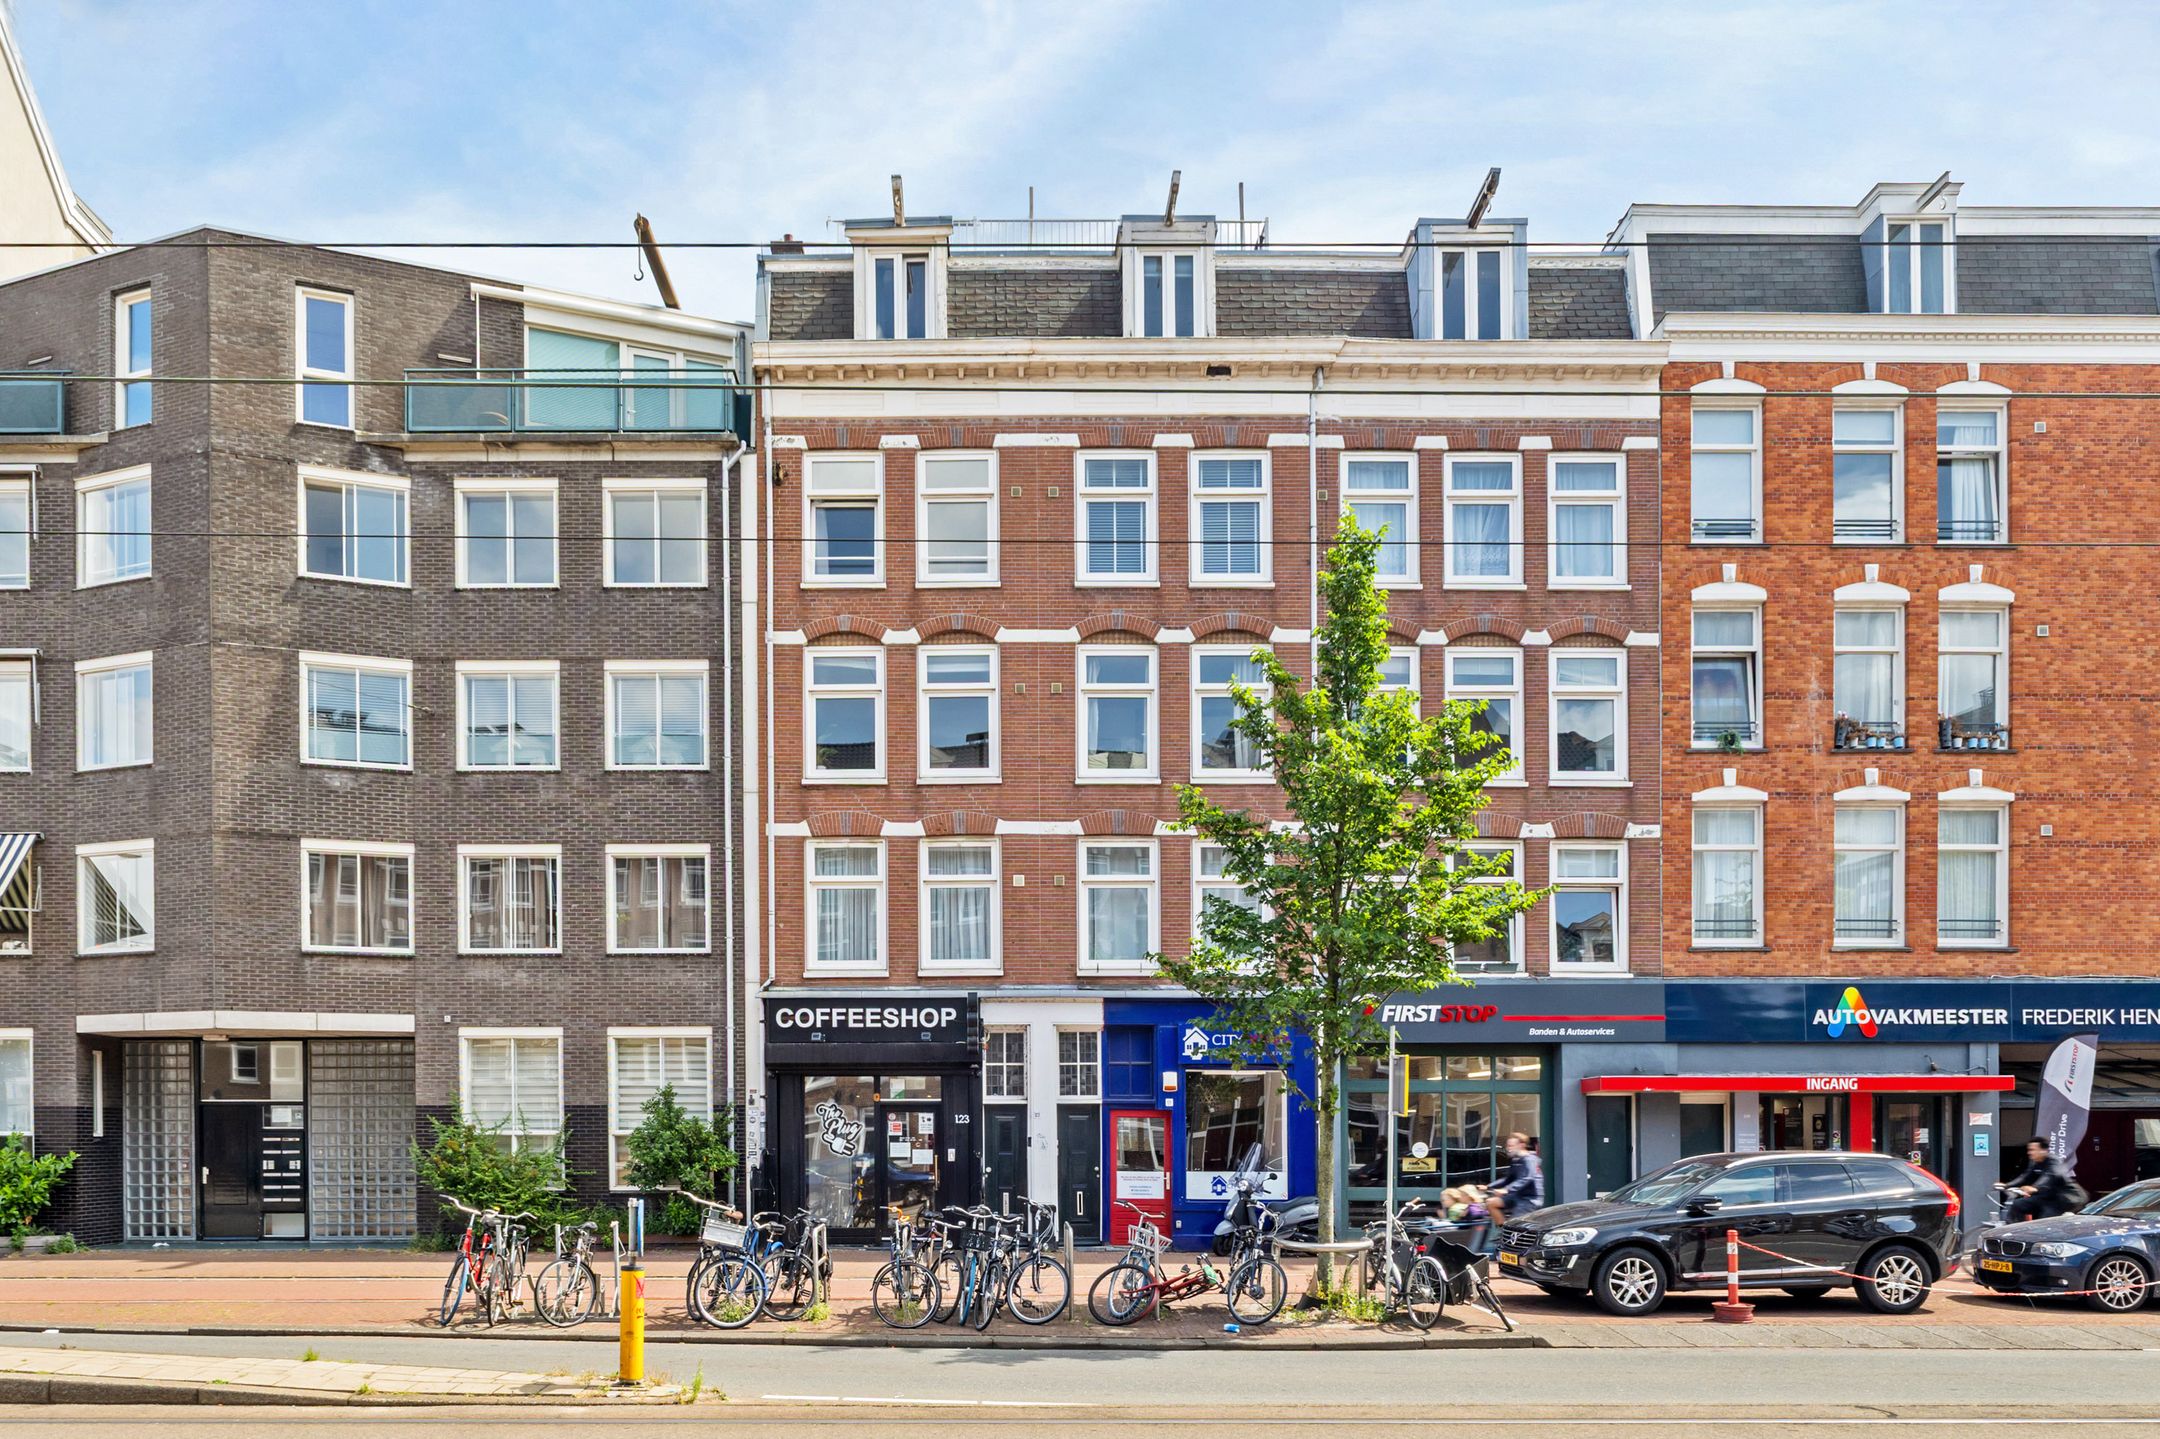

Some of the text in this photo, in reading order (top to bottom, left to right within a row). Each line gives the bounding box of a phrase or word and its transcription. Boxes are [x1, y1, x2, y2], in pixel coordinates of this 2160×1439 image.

[775, 1007, 957, 1028] COFFEESHOP
[1381, 1004, 1498, 1023] FIRSTSTOP
[1812, 1008, 2008, 1025] AUTOVAKMEESTER
[2022, 1008, 2160, 1025] FREDERIK HEN
[1529, 1027, 1615, 1036] Banden & Autoservices
[2069, 1043, 2079, 1079] FIRSTSTOP
[1806, 1078, 1858, 1090] INGANG
[954, 1114, 970, 1124] 123
[824, 1117, 863, 1140] Plug
[2058, 1113, 2068, 1159] your Drive
